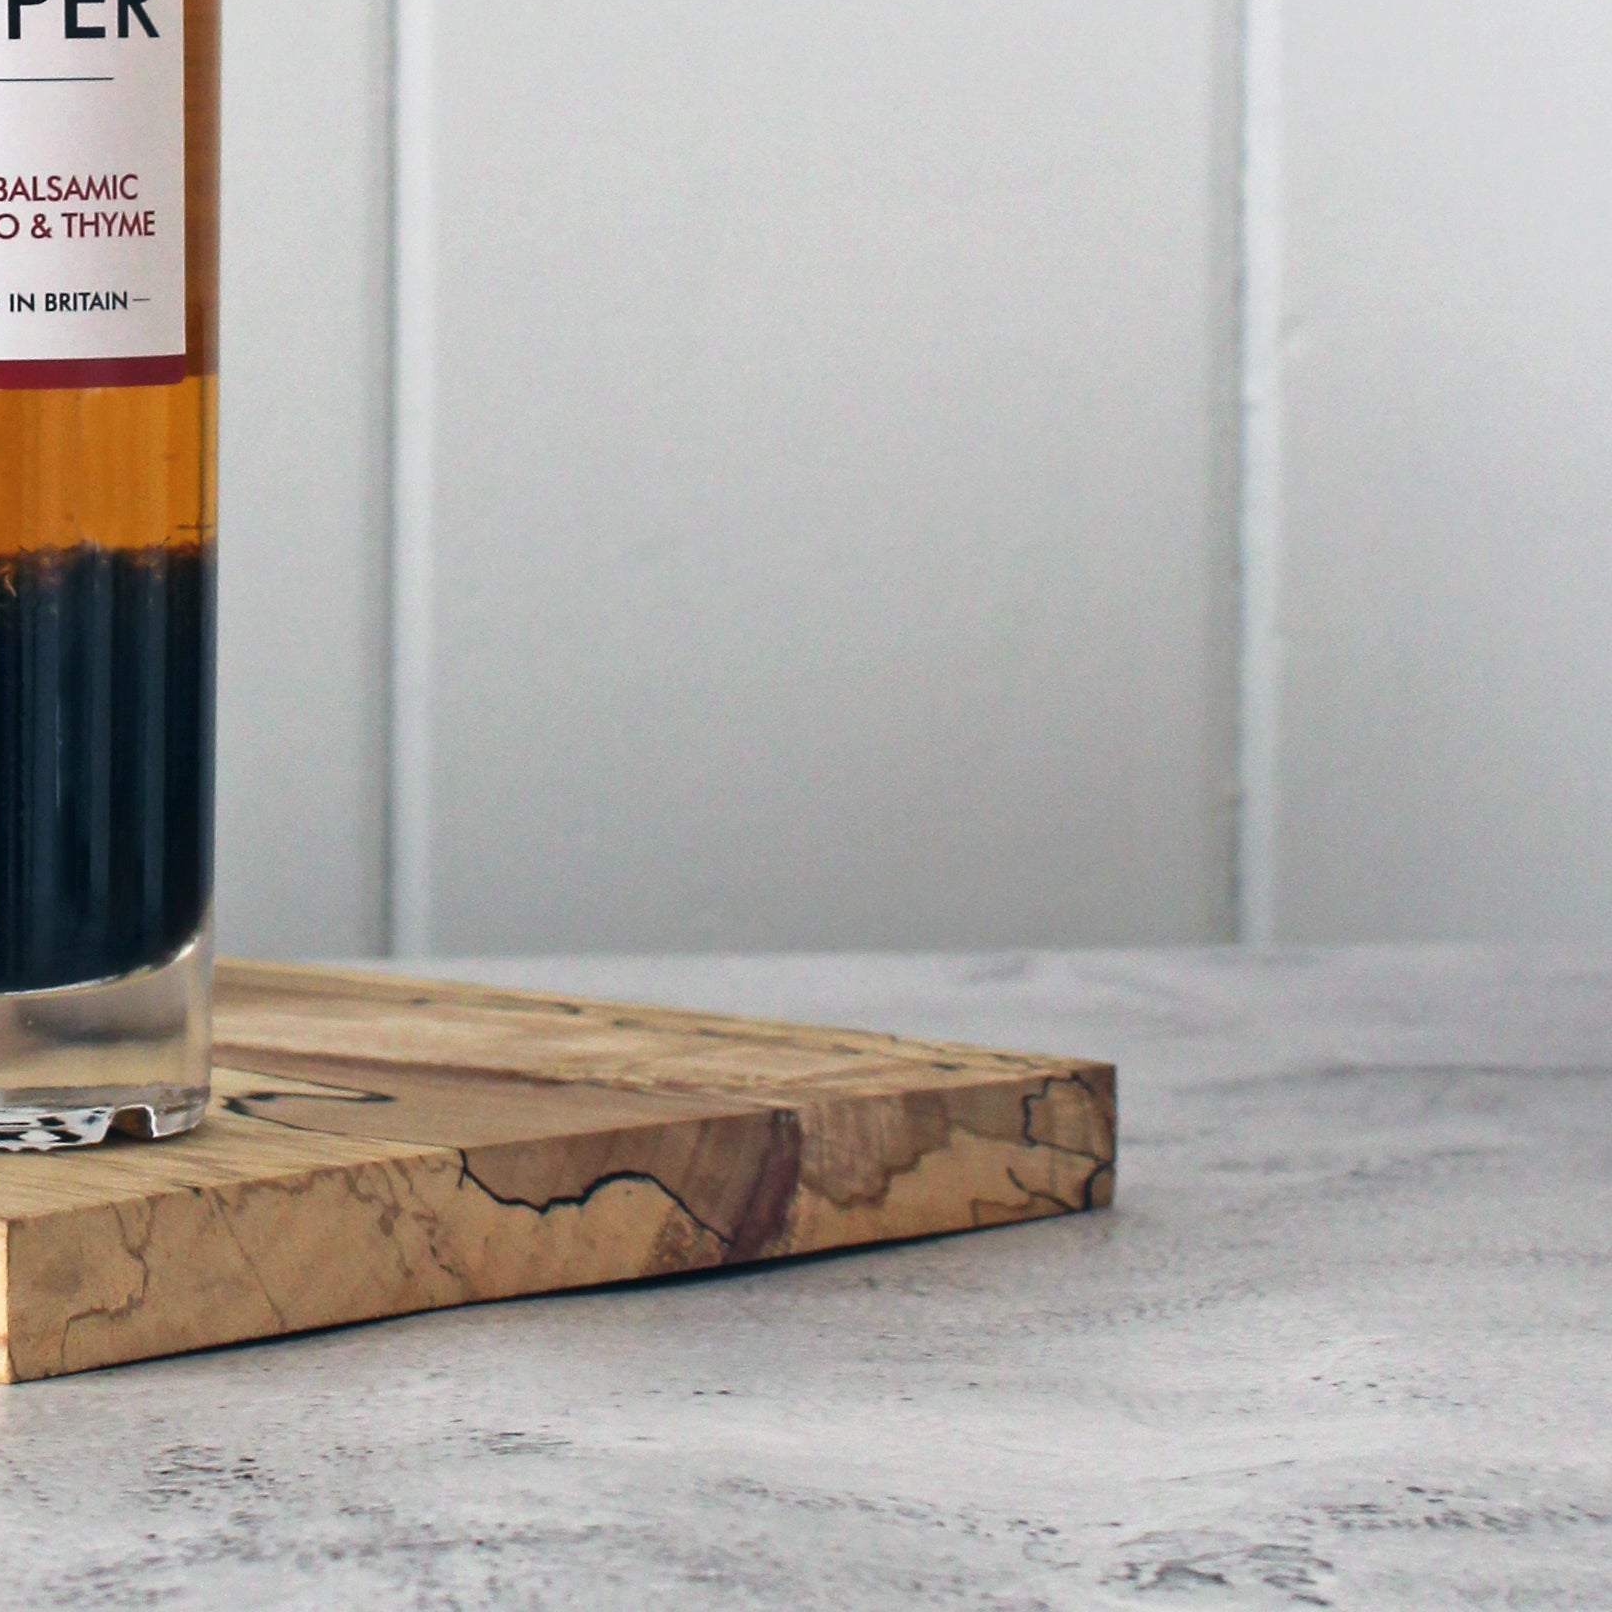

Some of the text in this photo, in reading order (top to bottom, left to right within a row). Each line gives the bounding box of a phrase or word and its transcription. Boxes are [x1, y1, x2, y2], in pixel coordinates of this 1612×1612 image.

[30, 213, 52, 239] &
[61, 210, 156, 238] THYME
[9, 293, 35, 312] IN
[44, 291, 129, 313] BRITAIN
